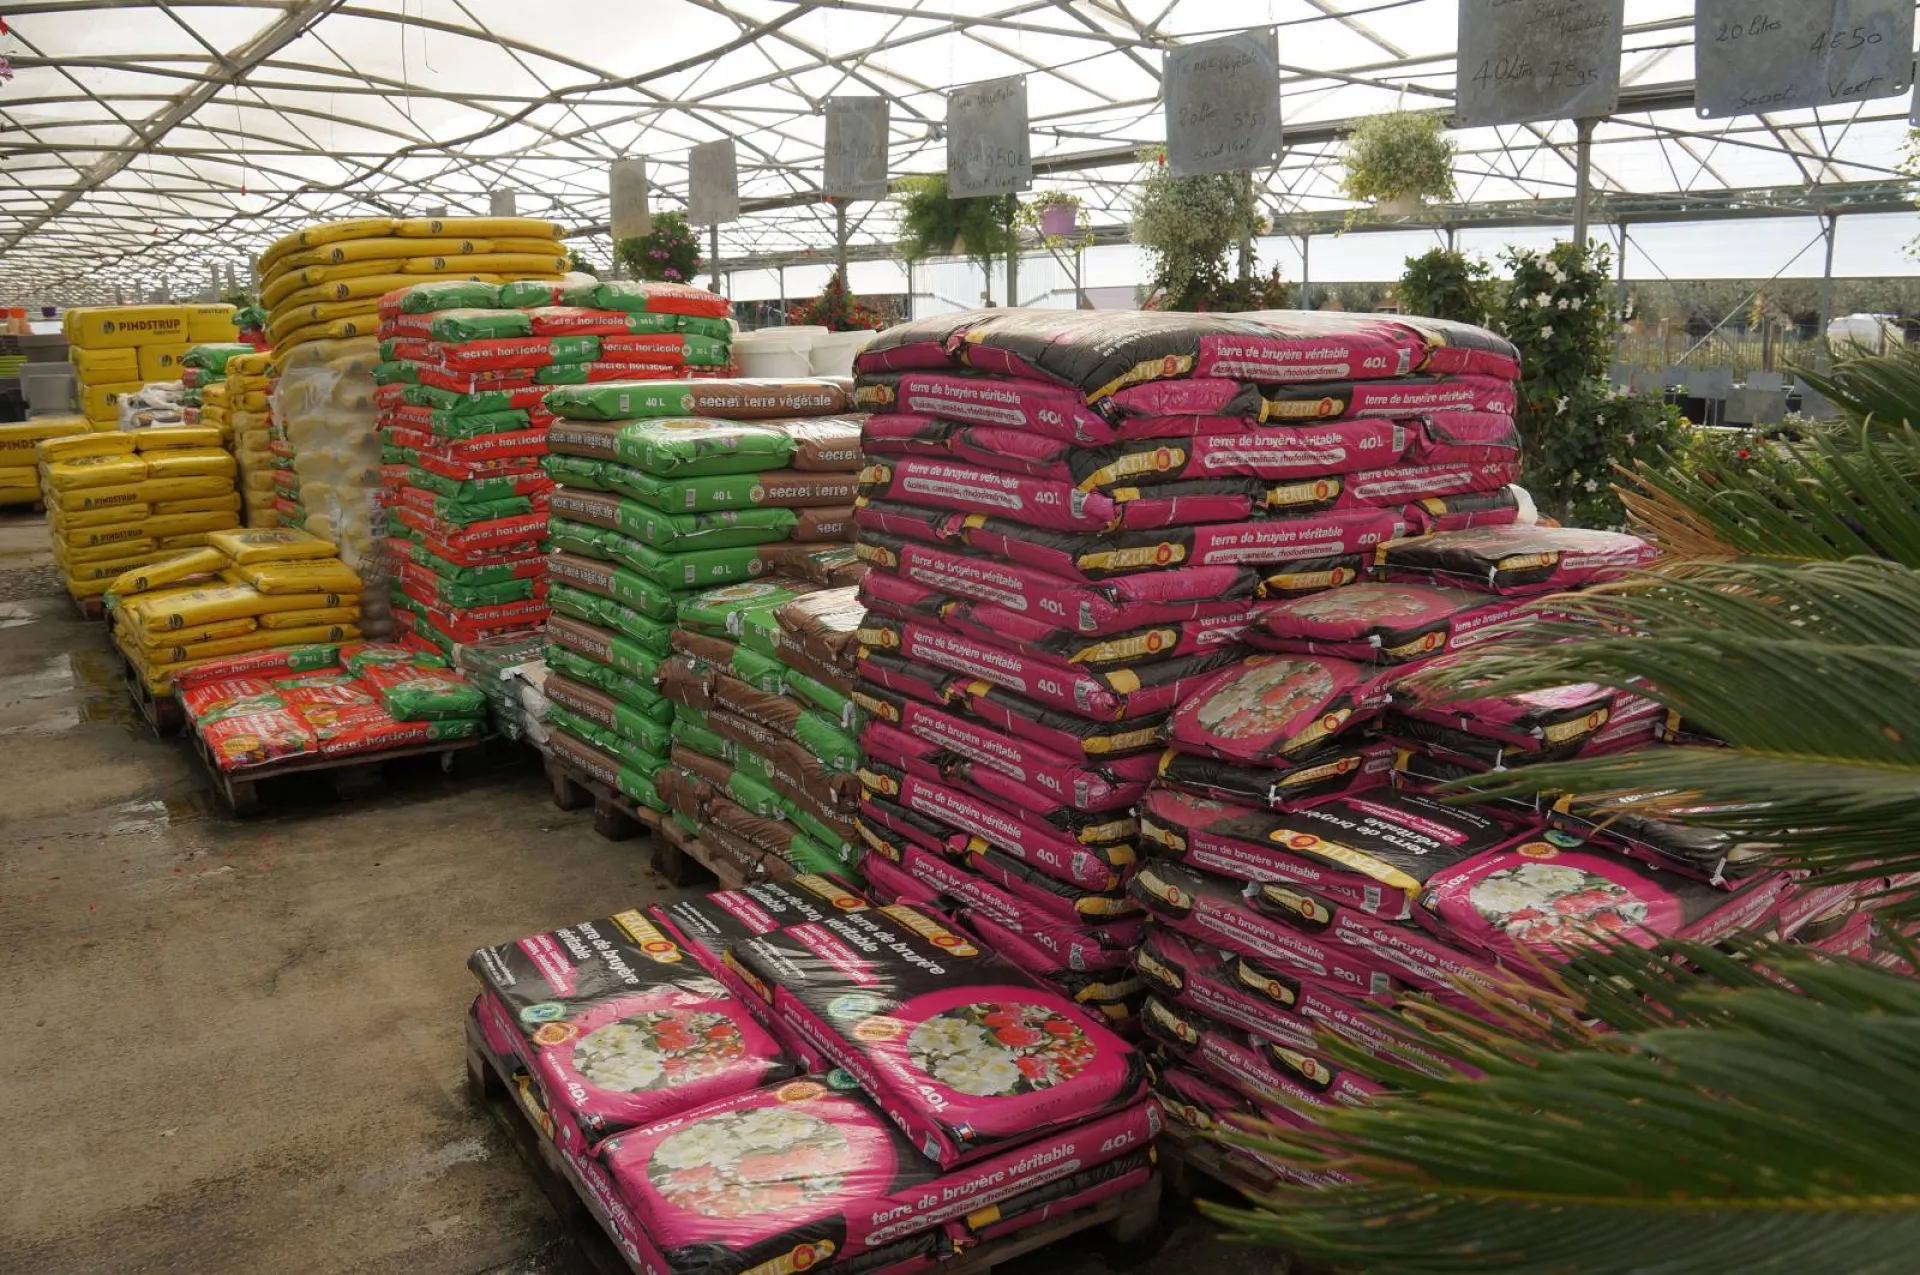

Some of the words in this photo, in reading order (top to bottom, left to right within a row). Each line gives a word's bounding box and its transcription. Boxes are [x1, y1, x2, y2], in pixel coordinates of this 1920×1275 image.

[1715, 24, 1743, 42] 20
[1827, 76, 1883, 99] Vert
[119, 318, 181, 331] PINDSTRUP
[577, 317, 624, 325] horticole
[456, 348, 493, 358] secret
[497, 344, 547, 356] horticole
[602, 343, 631, 351] secret
[636, 343, 680, 353] horticole
[1217, 346, 1242, 357] terre
[1246, 346, 1259, 357] de
[1262, 346, 1302, 361] bruyère
[1305, 347, 1349, 360] véritable
[1362, 356, 1388, 369] 40L
[699, 396, 740, 408] secret
[744, 397, 775, 407] terre
[780, 395, 831, 409] végétale
[910, 381, 929, 393] terre
[931, 382, 943, 394] de
[946, 384, 978, 400] bruyère
[980, 388, 1020, 404] véritable
[1365, 394, 1388, 405] terre
[1390, 394, 1401, 404] de
[646, 398, 657, 407] 40
[1209, 436, 1235, 447] terre
[1238, 436, 1252, 446] de
[1254, 436, 1296, 449] bruyère
[1359, 434, 1383, 450] 40L
[818, 450, 857, 461] secret
[907, 462, 928, 475] terre
[930, 464, 941, 476] de
[943, 467, 978, 481] bruyère
[95, 493, 137, 505] PINDSTRUP
[713, 490, 725, 501] 40
[769, 485, 810, 498] secret
[816, 485, 848, 496] terre
[1035, 491, 1062, 505] 40L
[100, 529, 144, 542] PINDSTRUP
[496, 522, 546, 536] horticole
[1211, 534, 1239, 546] terre
[1240, 532, 1255, 543] de
[1257, 531, 1296, 544] bruyère
[1299, 526, 1343, 541] véritable
[912, 553, 932, 567] terre
[934, 558, 945, 570] de
[947, 561, 980, 578] bruyère
[981, 569, 1024, 589] véritable
[1039, 598, 1066, 616] 40L
[913, 632, 933, 646] terre
[935, 636, 946, 649] de
[946, 640, 980, 660] bruyère
[982, 650, 1022, 672] véritable
[232, 657, 286, 673] horticole
[1038, 678, 1064, 697] 40L
[366, 728, 425, 746] horticole
[913, 712, 934, 728] terre
[935, 717, 946, 731] de
[947, 721, 980, 746] bruyère
[982, 735, 1022, 762] véritable
[1036, 773, 1063, 795] 40L
[912, 783, 933, 801] terre
[935, 790, 946, 804] de
[947, 794, 980, 819] bruyère
[982, 808, 1022, 838] véritable
[1356, 826, 1380, 836] de
[1364, 817, 1441, 849] véritable
[1382, 834, 1428, 855] terre
[1036, 848, 1062, 868] 40L
[1195, 839, 1217, 853] terre
[1219, 843, 1232, 856] de
[1235, 848, 1272, 867] bruyère
[1274, 860, 1320, 880] véritable
[936, 864, 947, 878] de
[981, 884, 1020, 918] véritable
[577, 921, 600, 940] terre
[824, 918, 879, 953] véritable
[1200, 902, 1221, 917] terre
[1223, 910, 1236, 923] de
[1238, 915, 1275, 940] bruyère
[1278, 929, 1325, 960] véritable
[1341, 916, 1369, 935] terre
[1373, 929, 1388, 942] de
[1390, 936, 1437, 963] bruyère
[593, 939, 611, 950] de
[846, 912, 880, 932] terre
[874, 930, 896, 944] de
[890, 942, 946, 976] bruyère
[601, 949, 639, 985] bruyère
[1333, 966, 1364, 986] 20L
[1306, 995, 1332, 1014] terre
[1334, 1008, 1348, 1021] de
[785, 1002, 803, 1021] terre
[814, 1028, 843, 1058] bruyère
[1230, 1048, 1242, 1063] de
[1243, 1058, 1279, 1086] bruyère
[567, 1082, 589, 1107] 40L
[919, 1084, 950, 1113] 40L
[889, 1108, 914, 1140] 40L
[1100, 1130, 1136, 1152] 40L
[871, 1202, 913, 1225] terre
[918, 1193, 938, 1210] de
[943, 1169, 1005, 1202] bruyère
[1008, 1143, 1076, 1176] véritable
